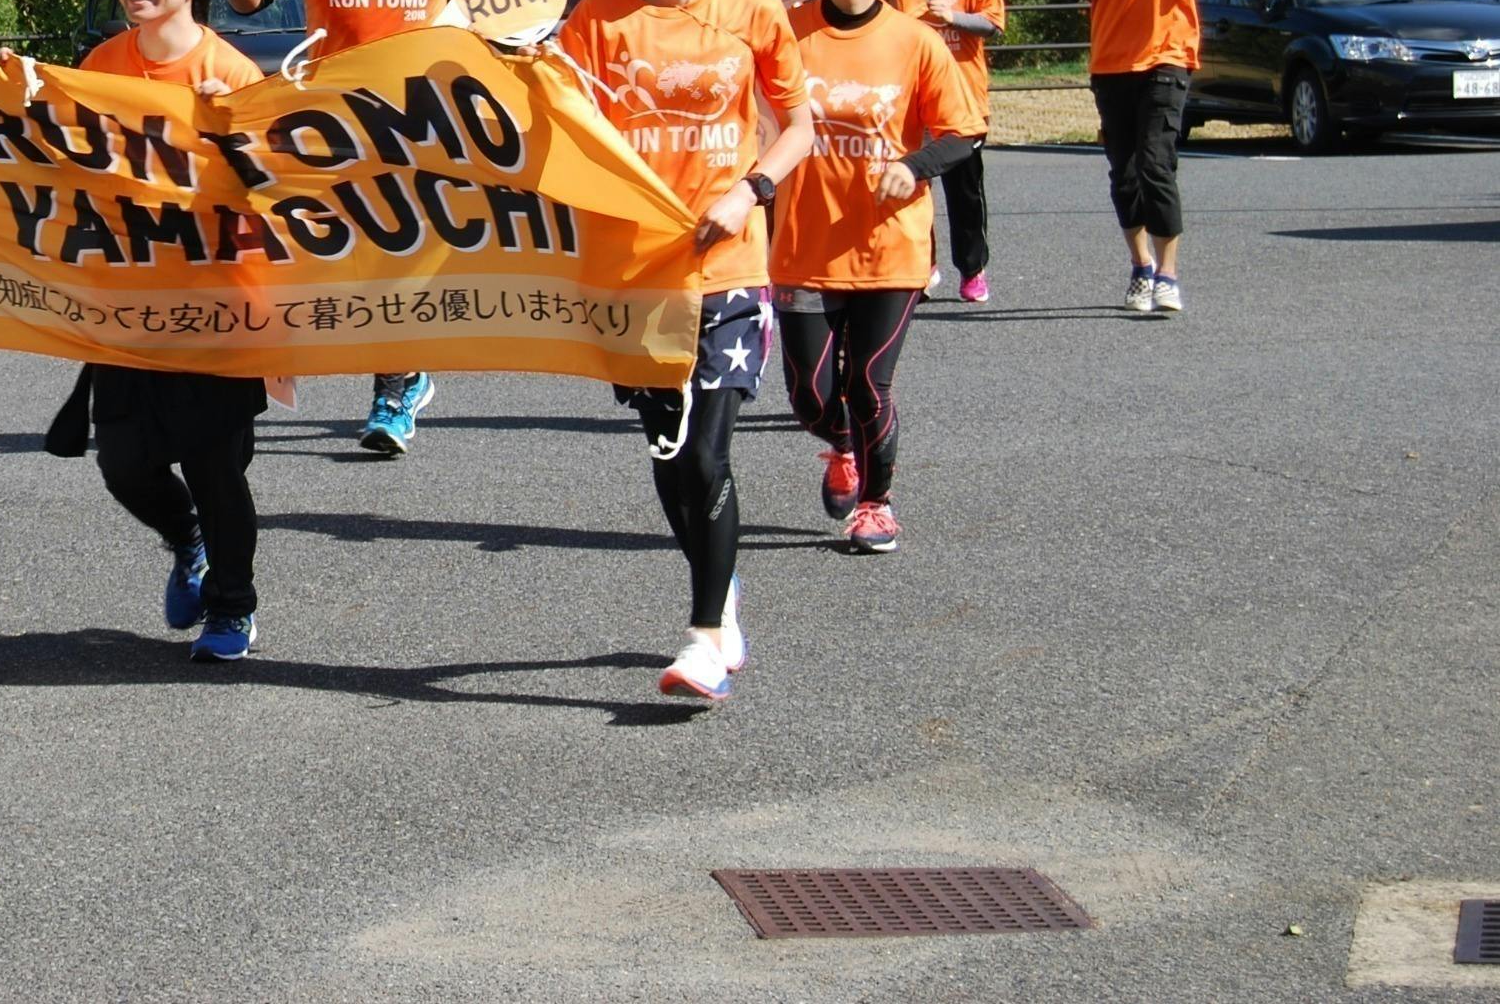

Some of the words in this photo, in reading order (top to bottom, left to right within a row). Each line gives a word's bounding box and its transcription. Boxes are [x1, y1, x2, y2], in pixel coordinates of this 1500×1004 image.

[197, 74, 526, 190] TOMO
[621, 127, 660, 153] UN
[667, 122, 740, 152] TOMO
[707, 151, 739, 168] 2018
